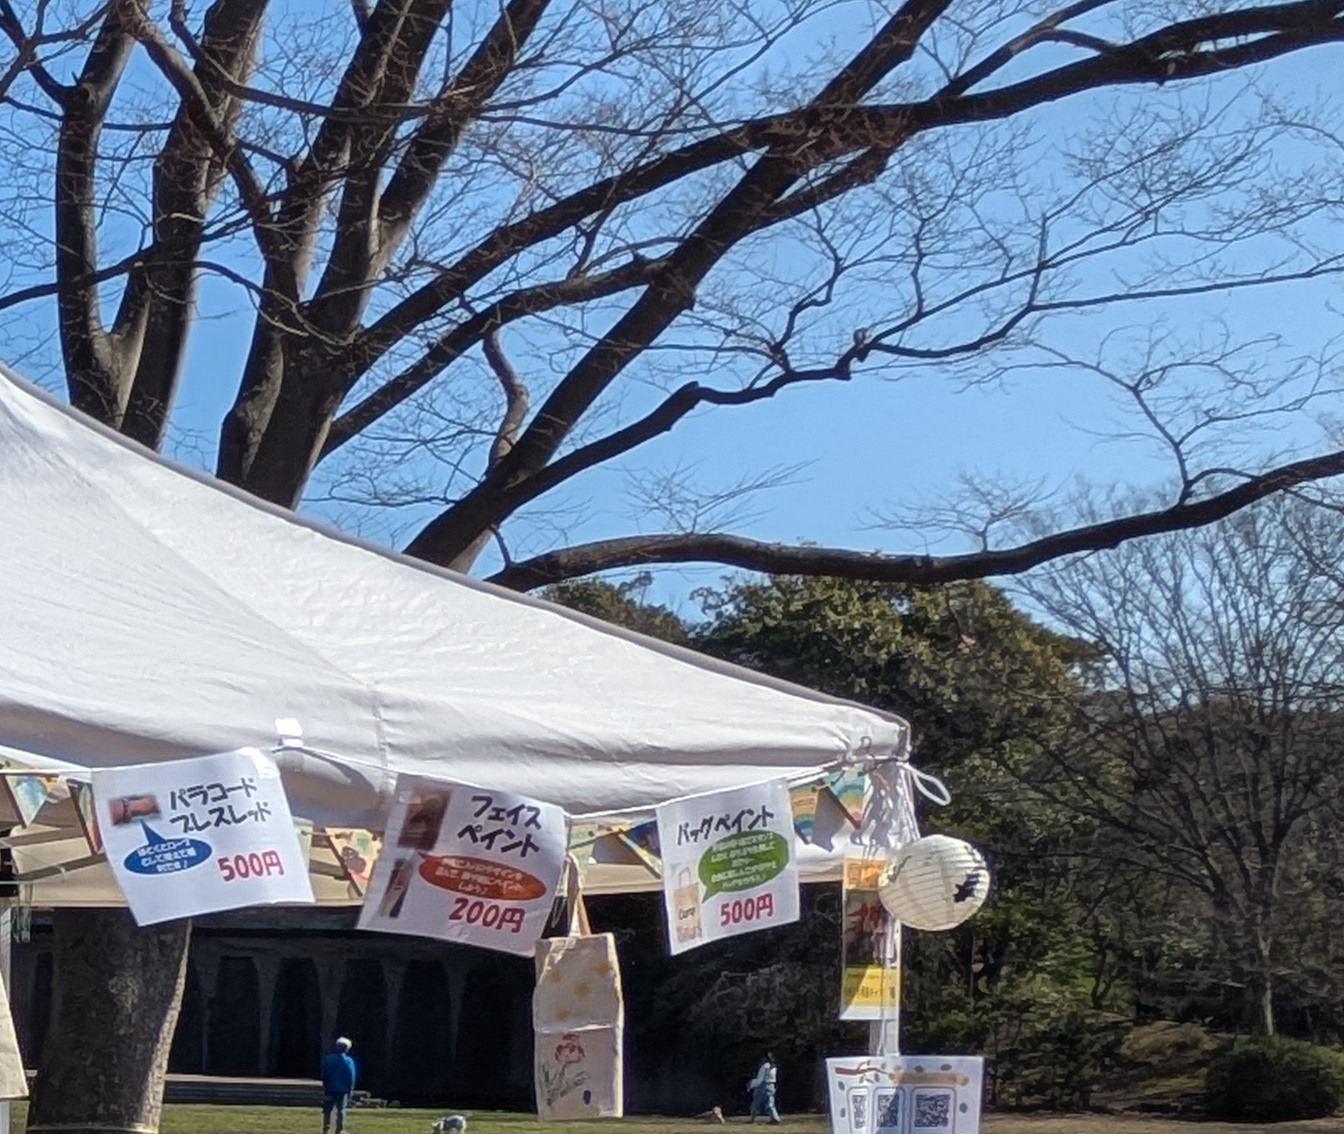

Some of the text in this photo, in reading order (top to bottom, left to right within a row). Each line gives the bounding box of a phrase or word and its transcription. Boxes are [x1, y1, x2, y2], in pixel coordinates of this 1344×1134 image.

[169, 777, 258, 811] パラコード
[471, 795, 542, 829] フェイス
[676, 805, 775, 846] バッグペイント
[457, 824, 541, 857] ペイント
[217, 850, 285, 882] 500円
[448, 898, 526, 933] 200円
[720, 893, 776, 927] 500円
